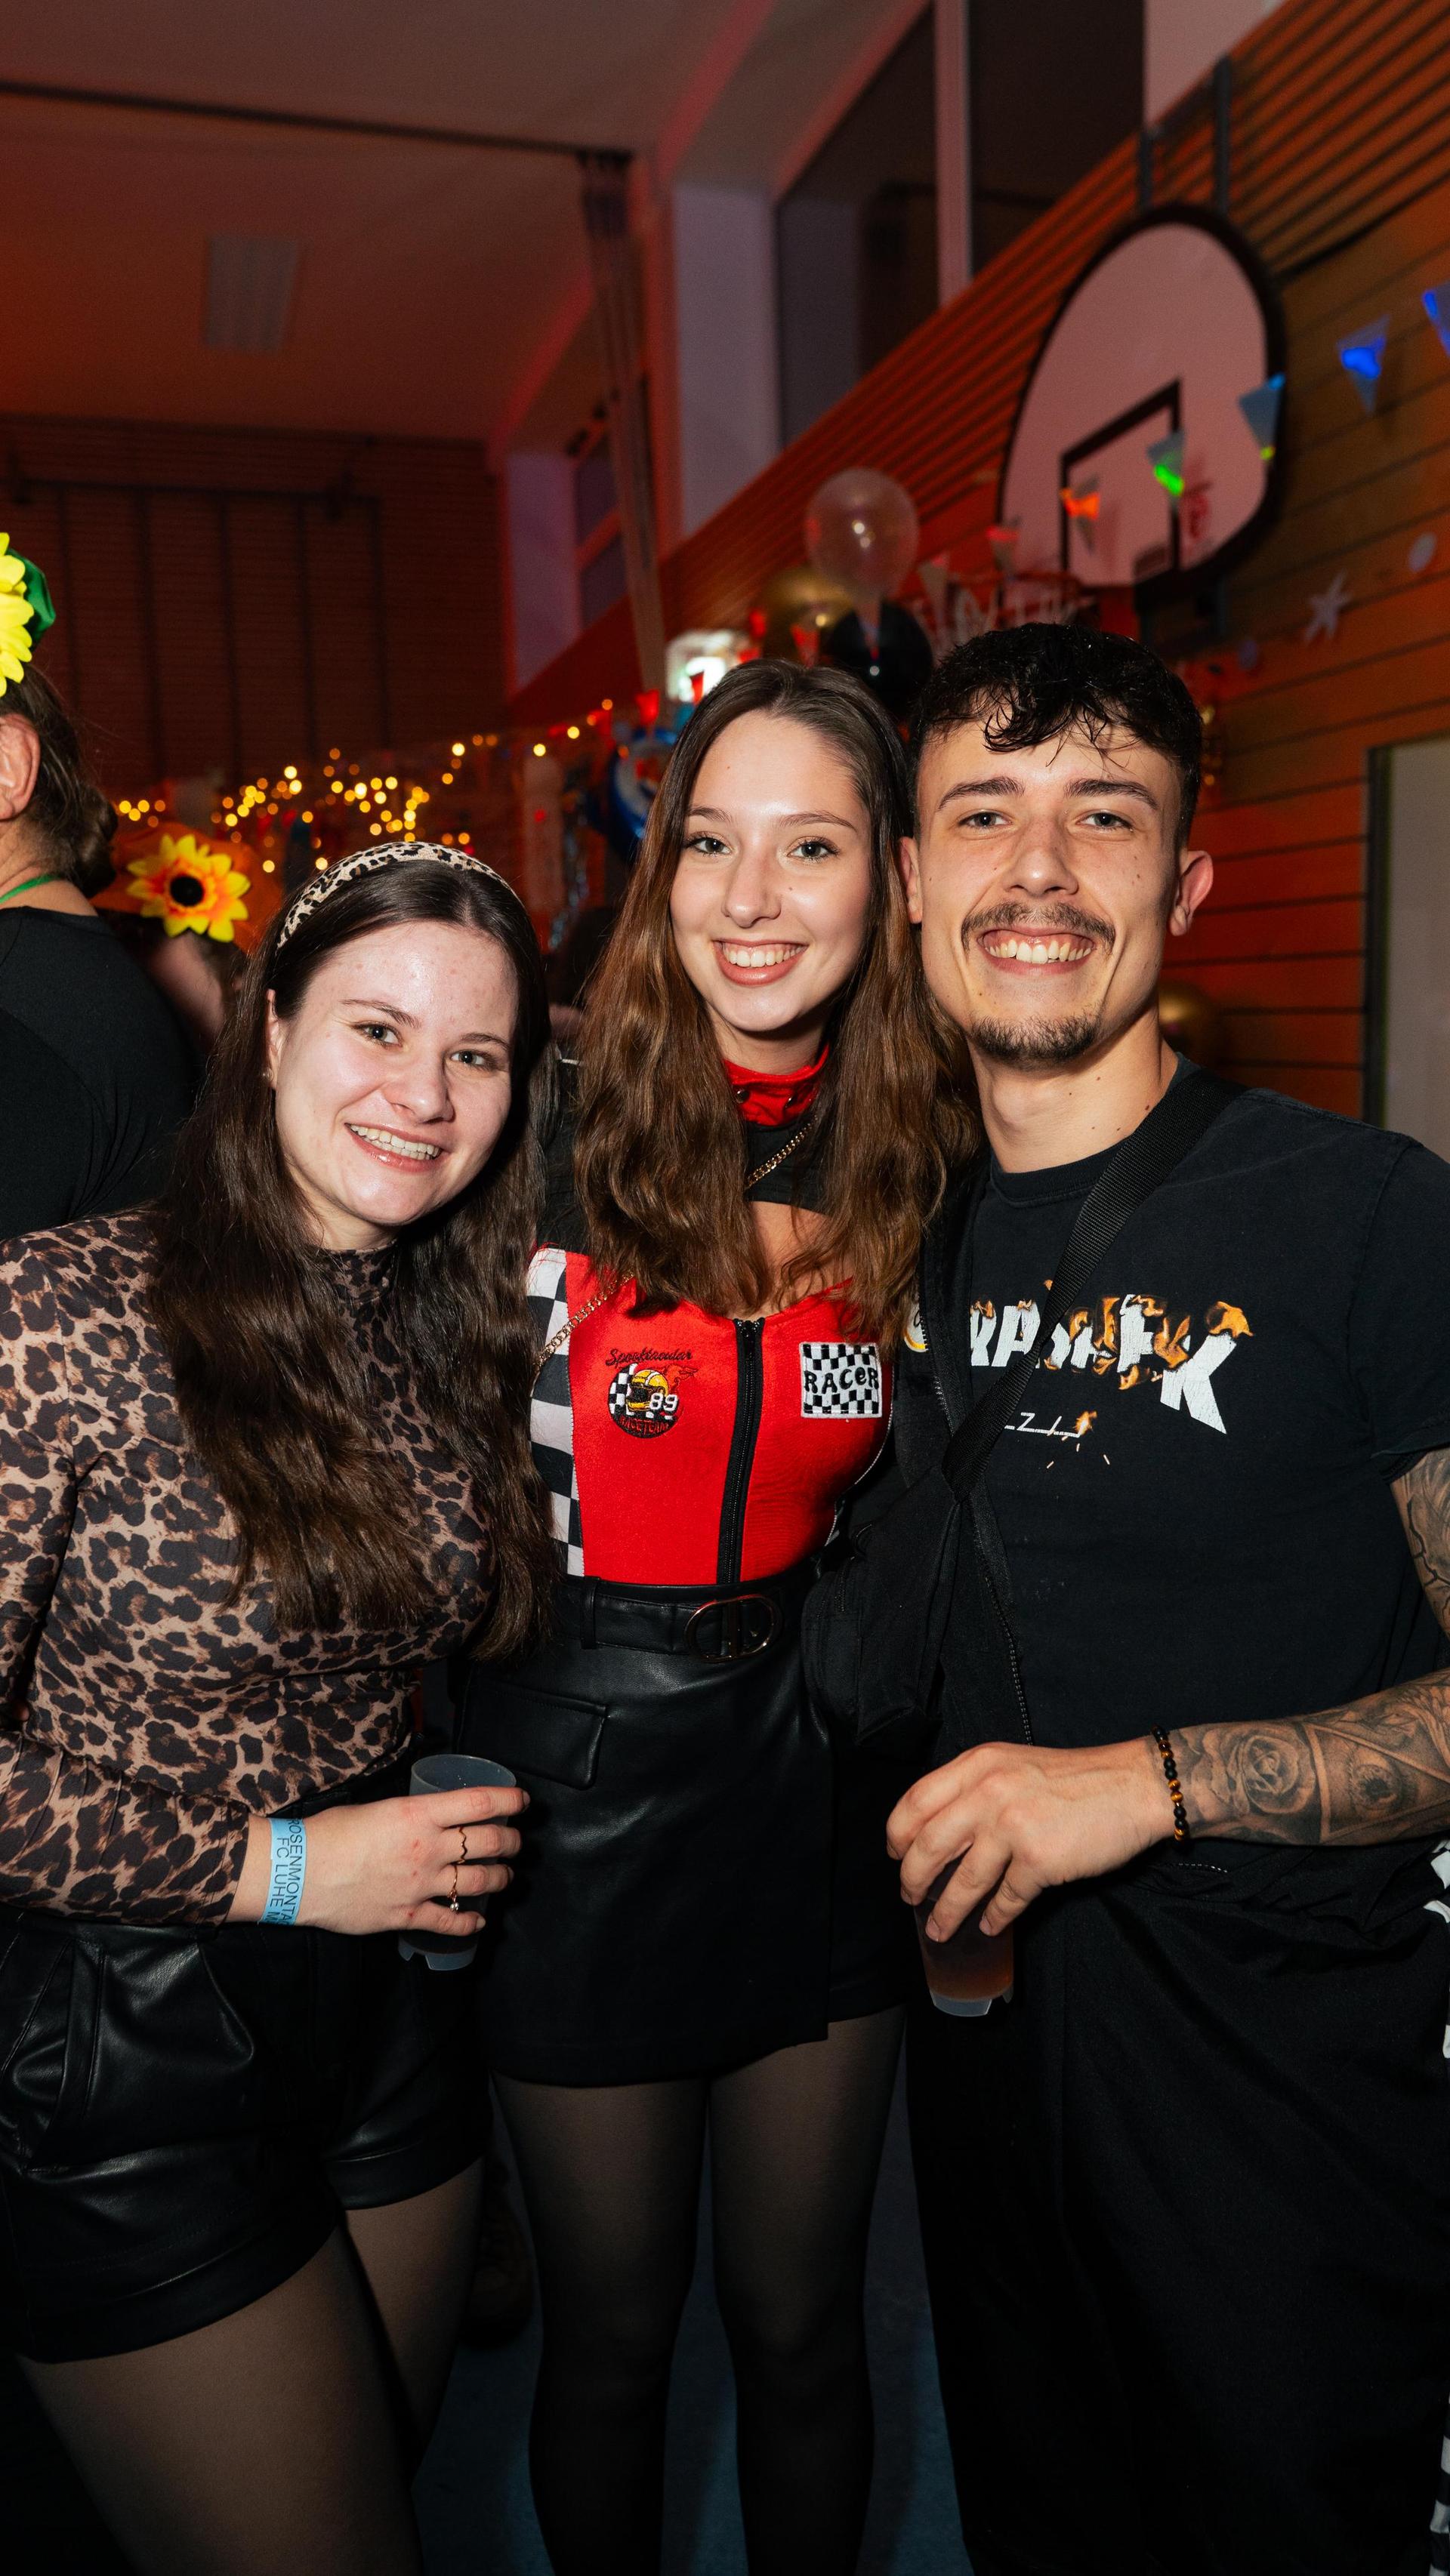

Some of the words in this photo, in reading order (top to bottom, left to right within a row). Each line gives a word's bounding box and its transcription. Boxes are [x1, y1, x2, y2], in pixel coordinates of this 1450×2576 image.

[649, 1392, 678, 1412] 89
[276, 1838, 289, 1858] FC
[270, 1864, 288, 1907] LUHE
